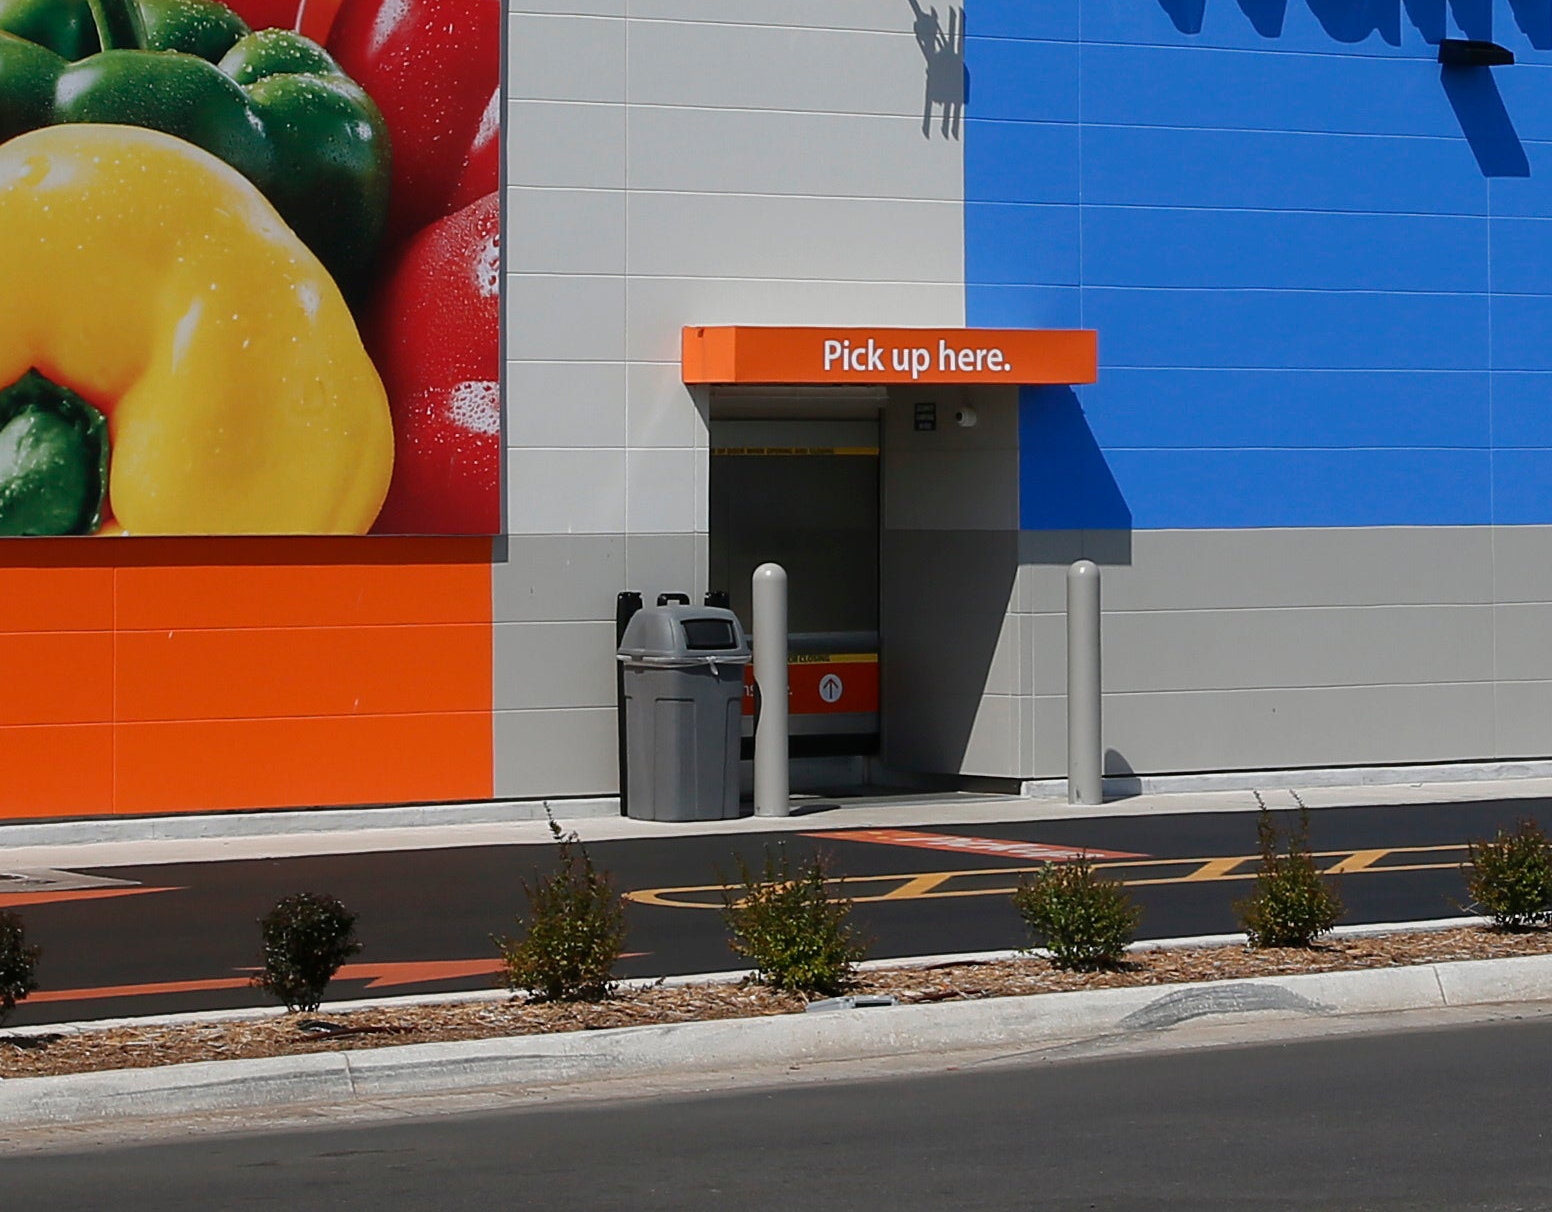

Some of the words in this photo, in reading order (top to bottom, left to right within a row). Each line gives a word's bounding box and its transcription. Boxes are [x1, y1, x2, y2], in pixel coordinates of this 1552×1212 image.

[823, 338, 886, 371] Pick
[891, 348, 931, 380] up
[938, 339, 1012, 372] here.
